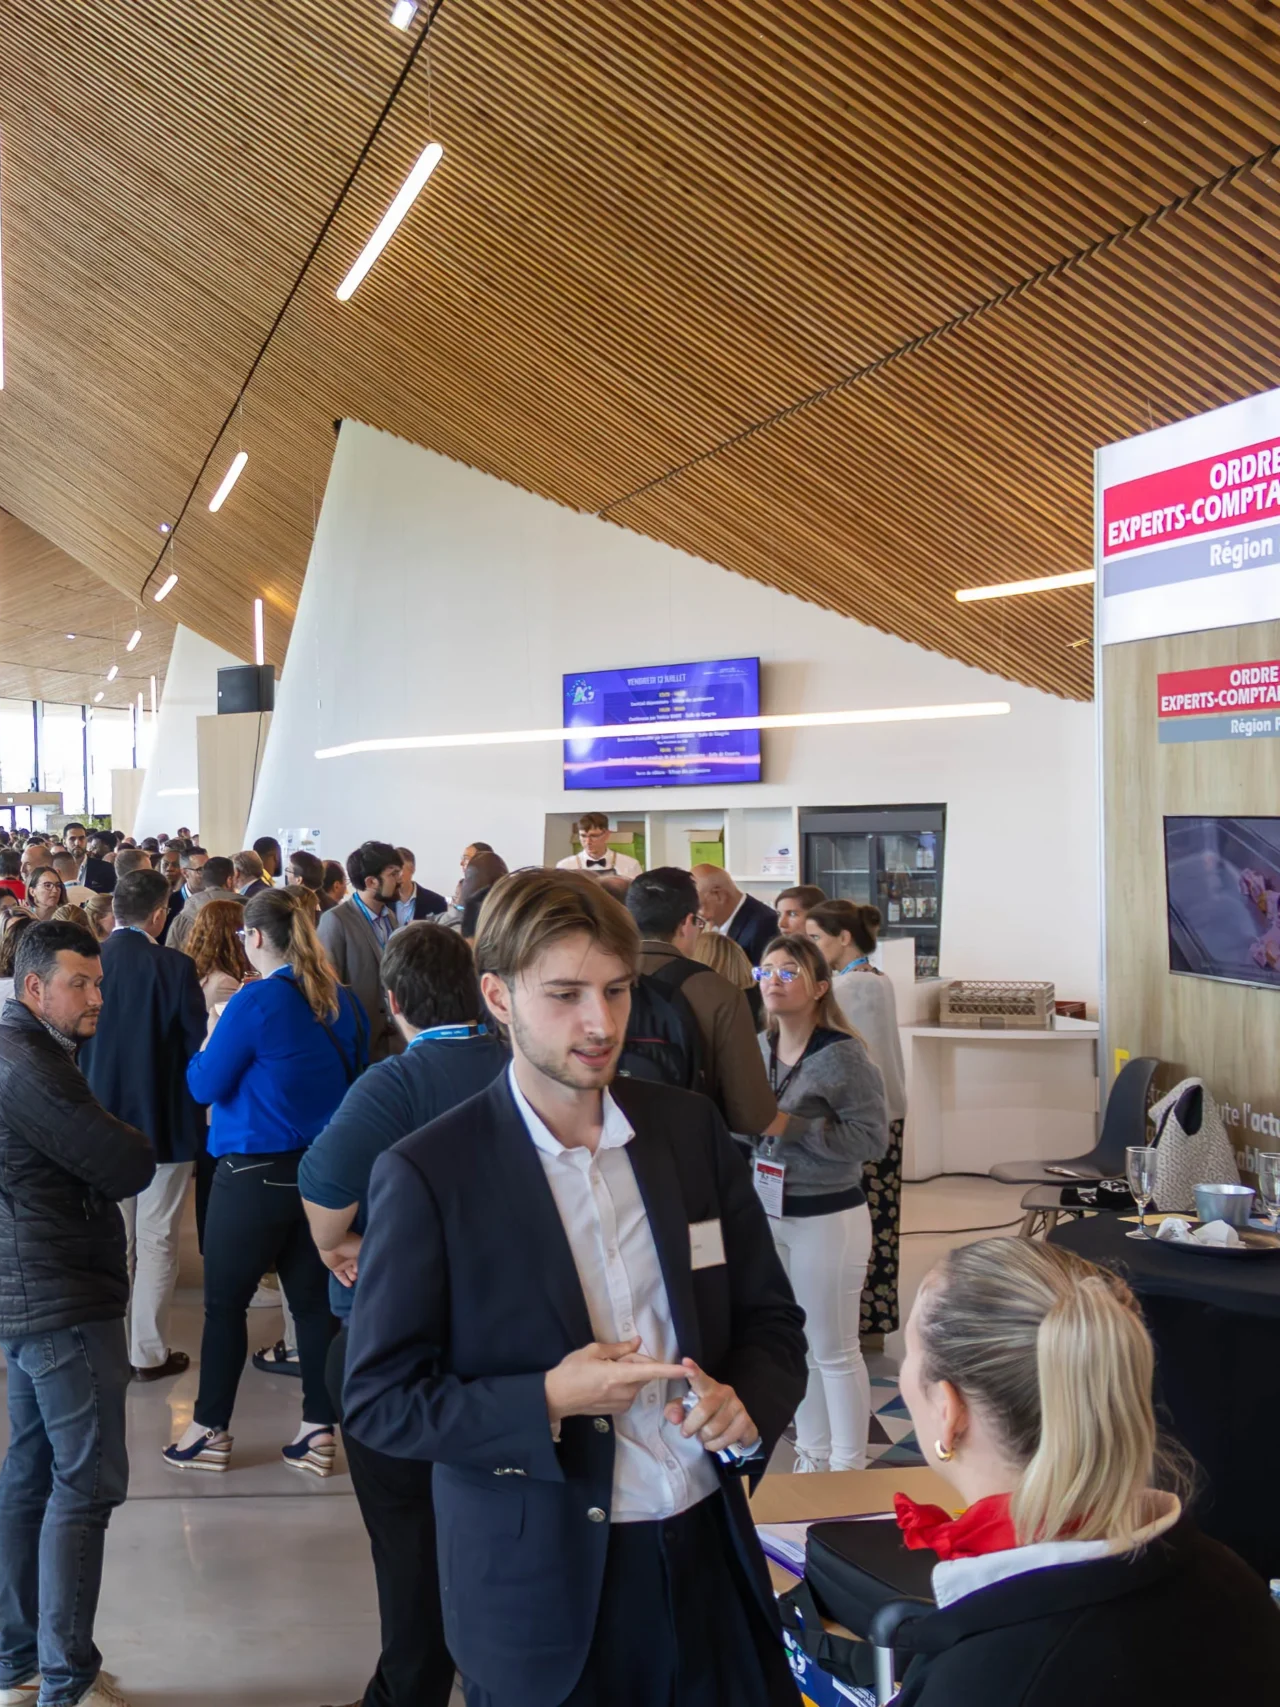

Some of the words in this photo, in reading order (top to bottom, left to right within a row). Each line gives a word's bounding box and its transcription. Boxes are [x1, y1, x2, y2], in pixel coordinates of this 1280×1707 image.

[1209, 445, 1280, 490] ORDRE
[1210, 537, 1273, 569] Région
[1230, 665, 1279, 686] ORDRE
[1230, 718, 1272, 737] Région
